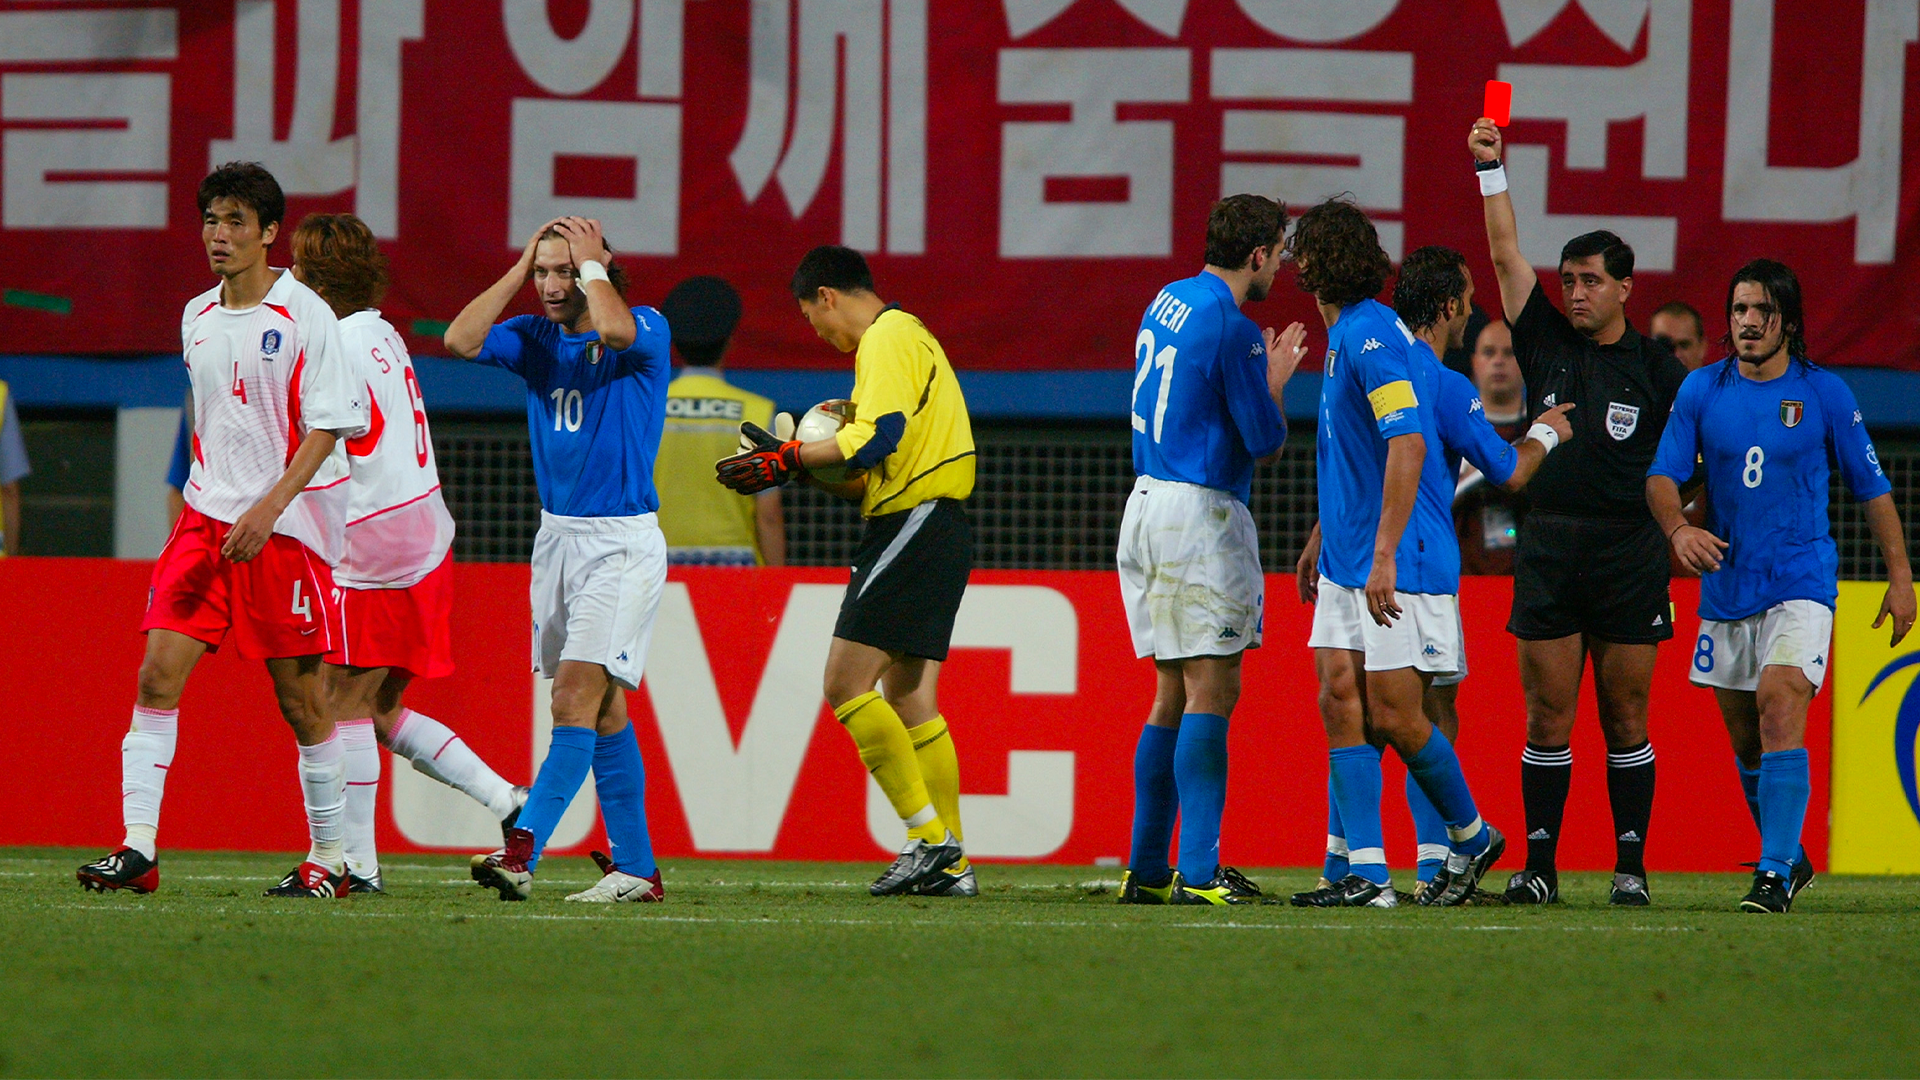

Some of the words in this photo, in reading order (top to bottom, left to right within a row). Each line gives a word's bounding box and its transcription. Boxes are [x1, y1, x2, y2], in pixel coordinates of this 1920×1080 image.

[1150, 288, 1193, 334] VIERI
[232, 361, 248, 404] 4
[1131, 328, 1178, 444] 21
[404, 366, 429, 468] 6
[550, 388, 584, 432] 10
[666, 398, 742, 420] OLICE
[1612, 425, 1627, 434] FIFA
[1742, 445, 1765, 489] 8
[291, 579, 312, 622] 4
[1693, 633, 1714, 673] 8
